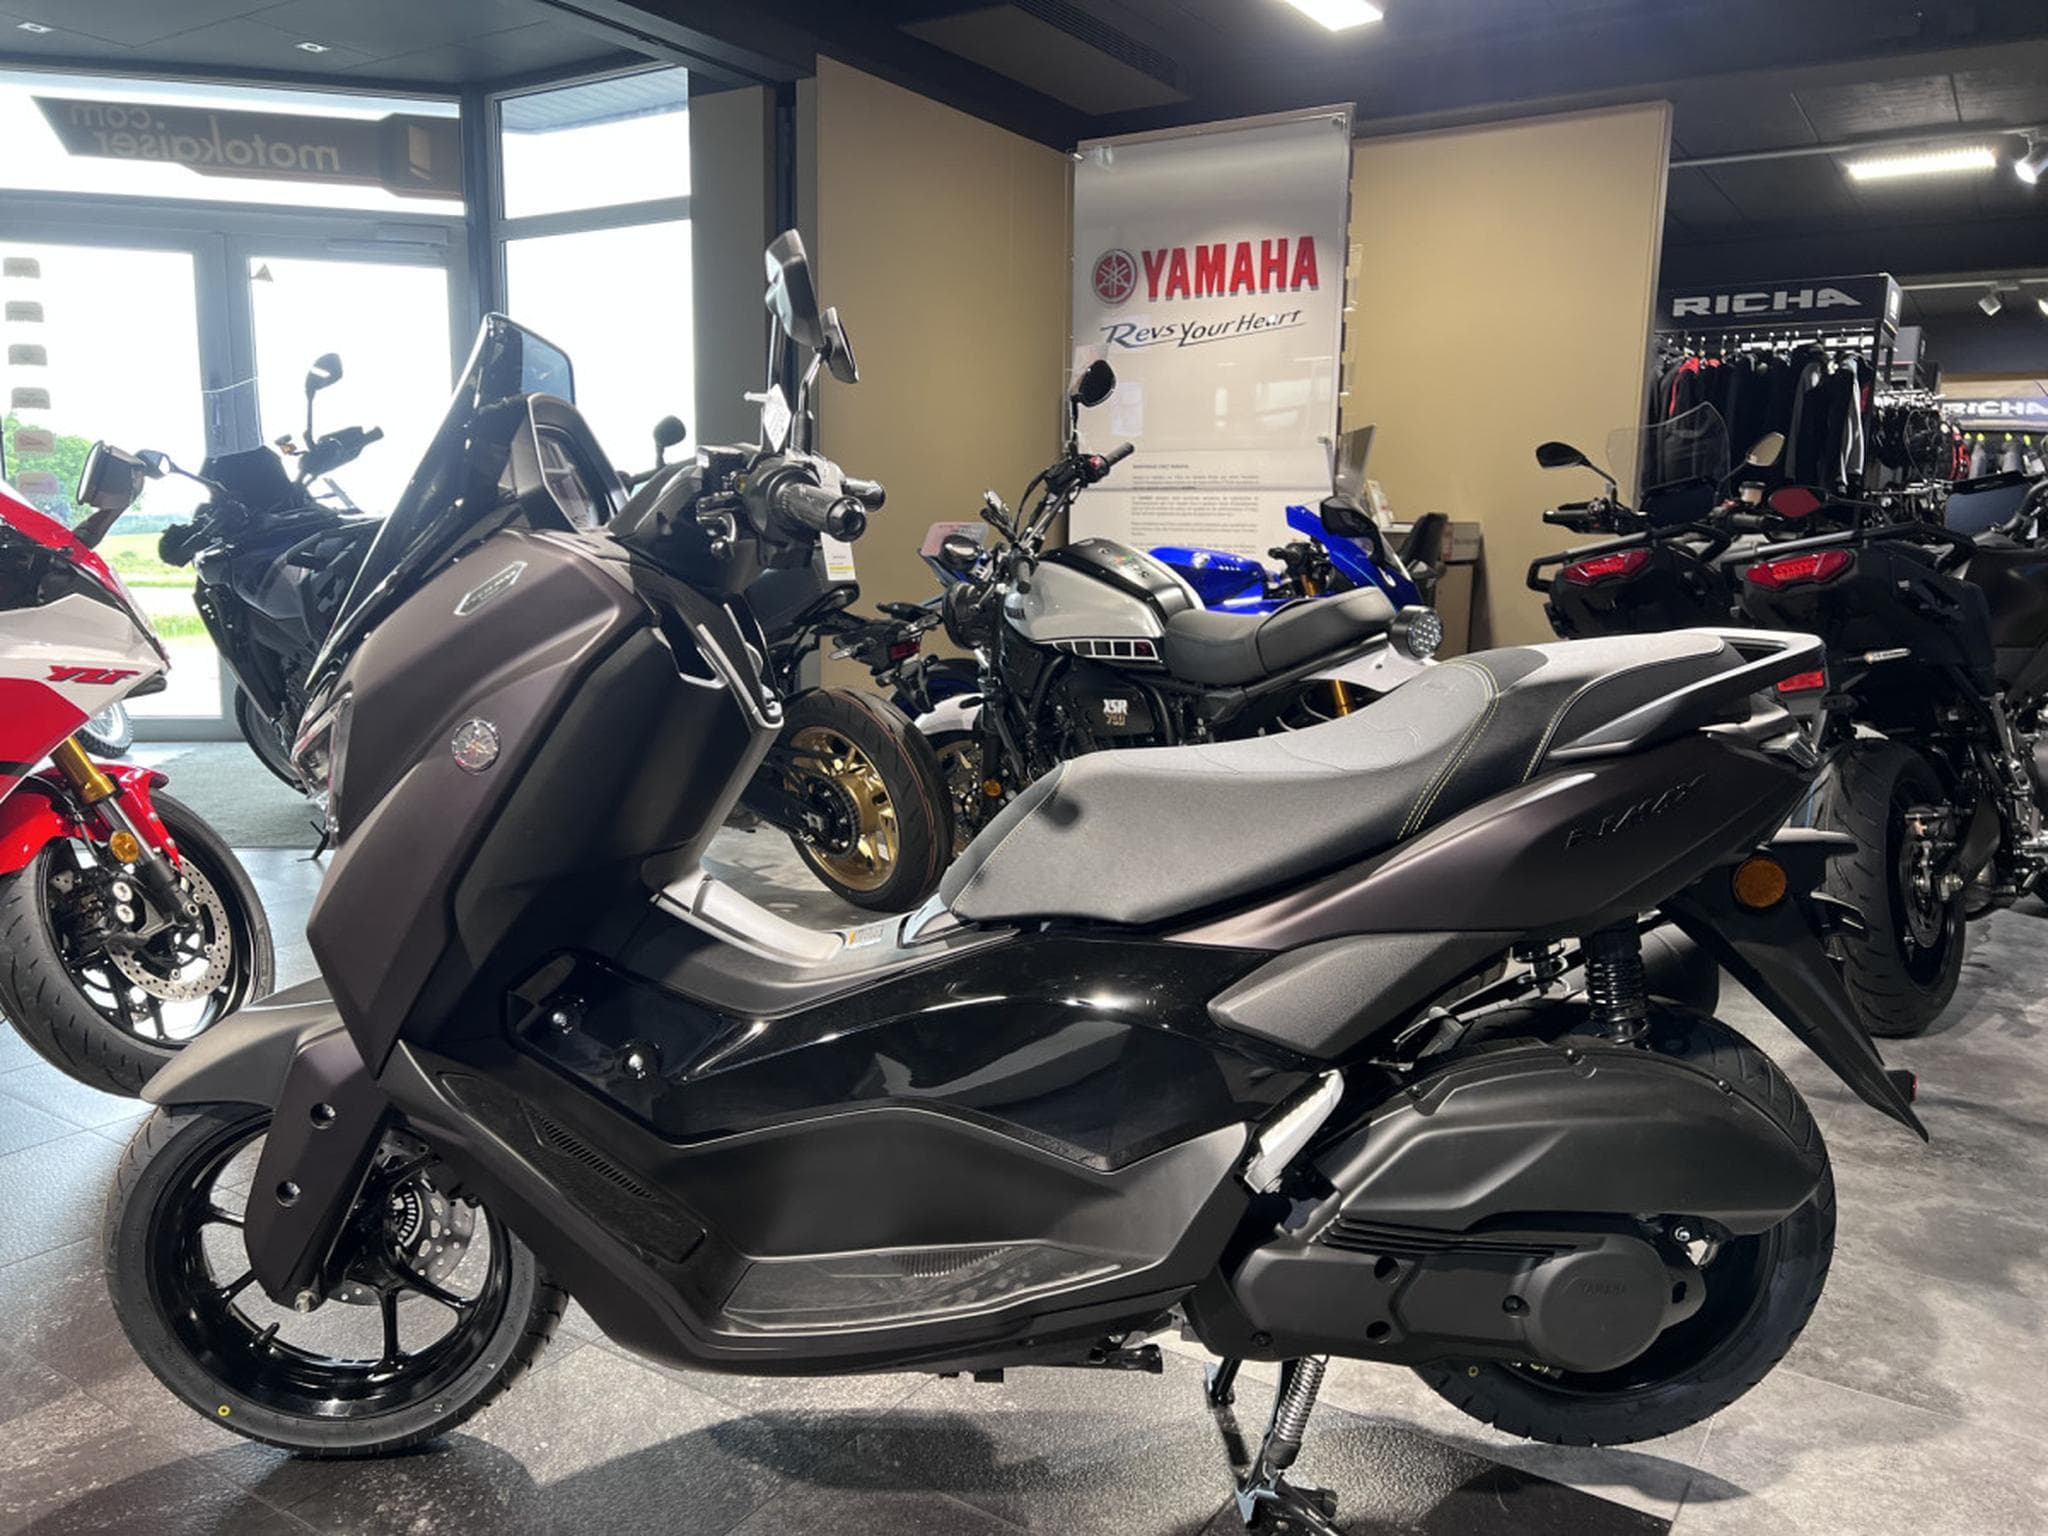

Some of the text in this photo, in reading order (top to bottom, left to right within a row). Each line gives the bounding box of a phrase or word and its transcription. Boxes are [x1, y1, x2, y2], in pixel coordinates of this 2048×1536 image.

[1142, 236, 1319, 302] YAMAHA
[1672, 287, 1862, 317] RICHA
[1100, 310, 1303, 348] Revs Your Heart
[1941, 401, 2048, 416] RICHA
[1103, 699, 1128, 715] XSR
